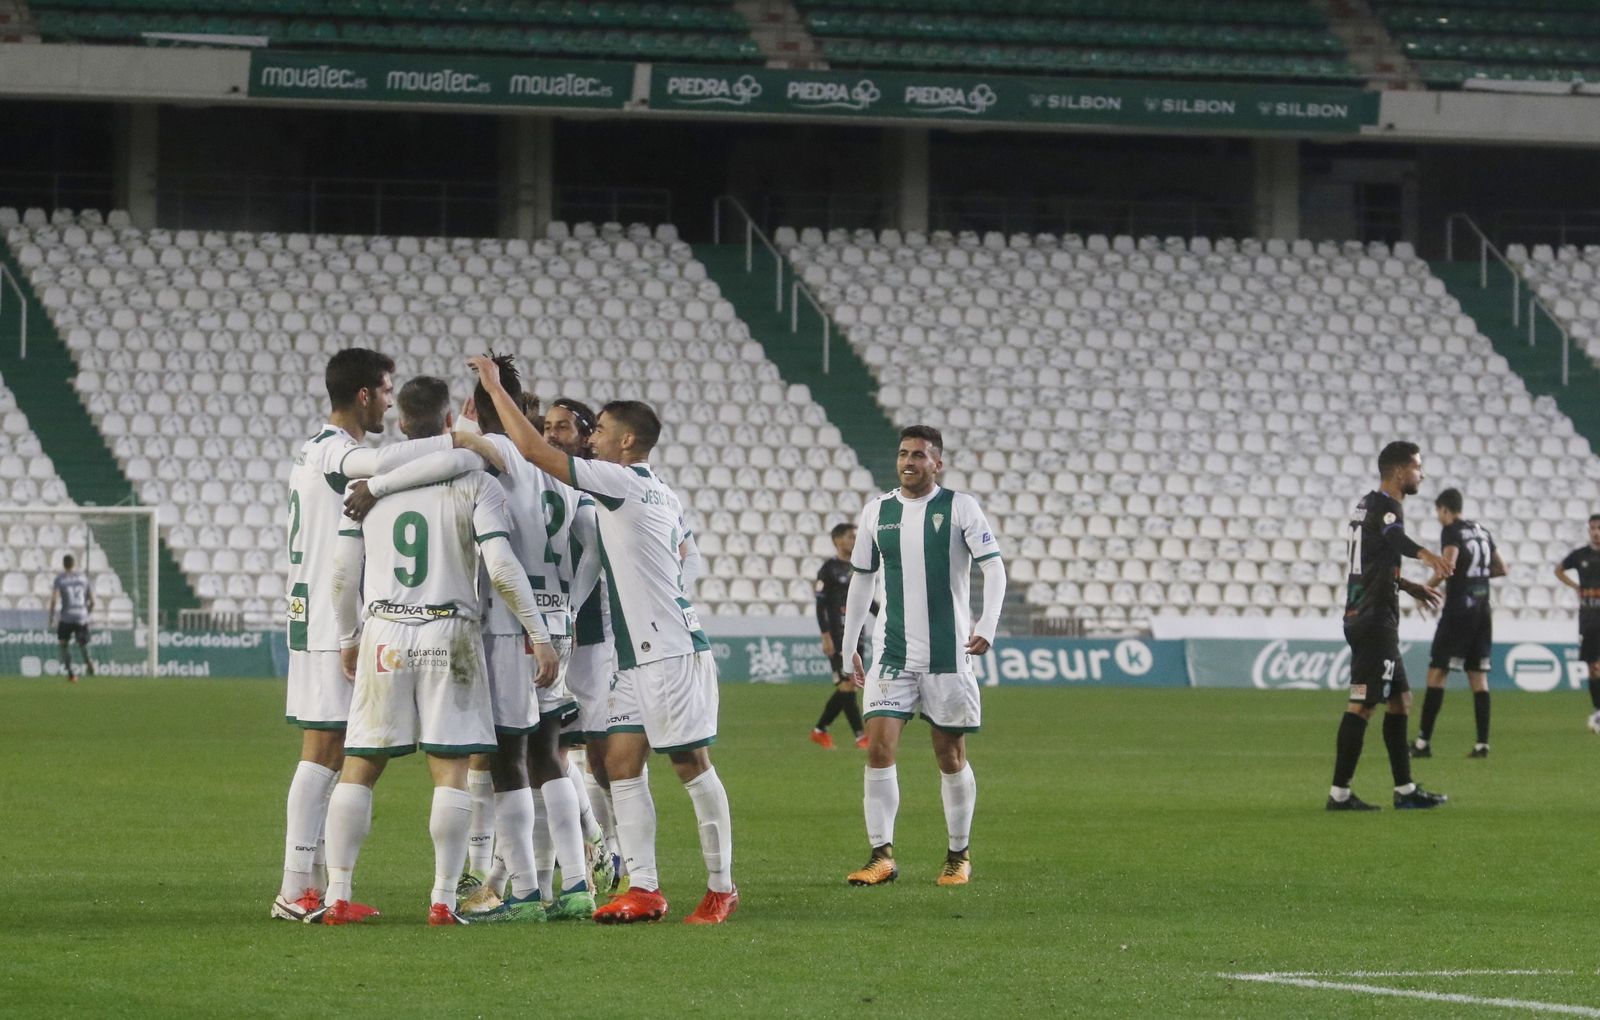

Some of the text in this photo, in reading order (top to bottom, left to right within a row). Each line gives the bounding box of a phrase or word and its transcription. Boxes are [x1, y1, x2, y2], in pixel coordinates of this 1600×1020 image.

[667, 77, 731, 96] PIEDRA
[787, 81, 849, 101] PIEDRA
[904, 86, 966, 105] PIEDRA
[1047, 94, 1122, 110] SILBON
[1161, 98, 1236, 114] SILBON
[1275, 102, 1348, 118] SILBON
[393, 511, 429, 589] 9
[374, 603, 424, 616] PIEDRA
[158, 631, 262, 647] @CordobaCF
[973, 648, 1110, 686] jasur
[1253, 639, 1352, 690] Coca-C
[1382, 659, 1395, 680] 21
